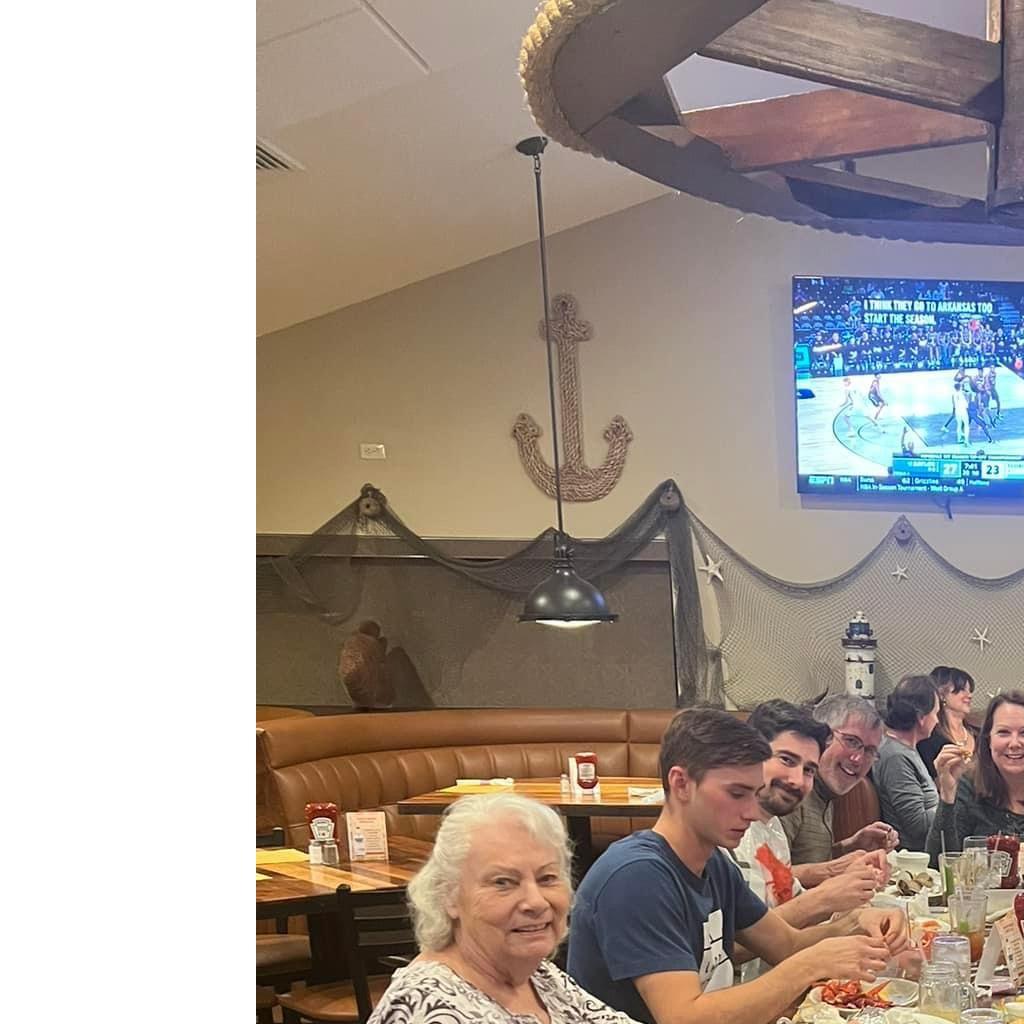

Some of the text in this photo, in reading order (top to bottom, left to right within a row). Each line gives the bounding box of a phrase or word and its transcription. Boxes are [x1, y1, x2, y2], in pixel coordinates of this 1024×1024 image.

[869, 300, 892, 311] THINK
[893, 300, 912, 311] THEY
[926, 301, 936, 312] TO
[938, 302, 976, 313] ARKANSAS
[978, 302, 993, 313] TOO
[864, 313, 887, 324] START
[889, 314, 904, 324] THE
[986, 465, 1000, 475] 23
